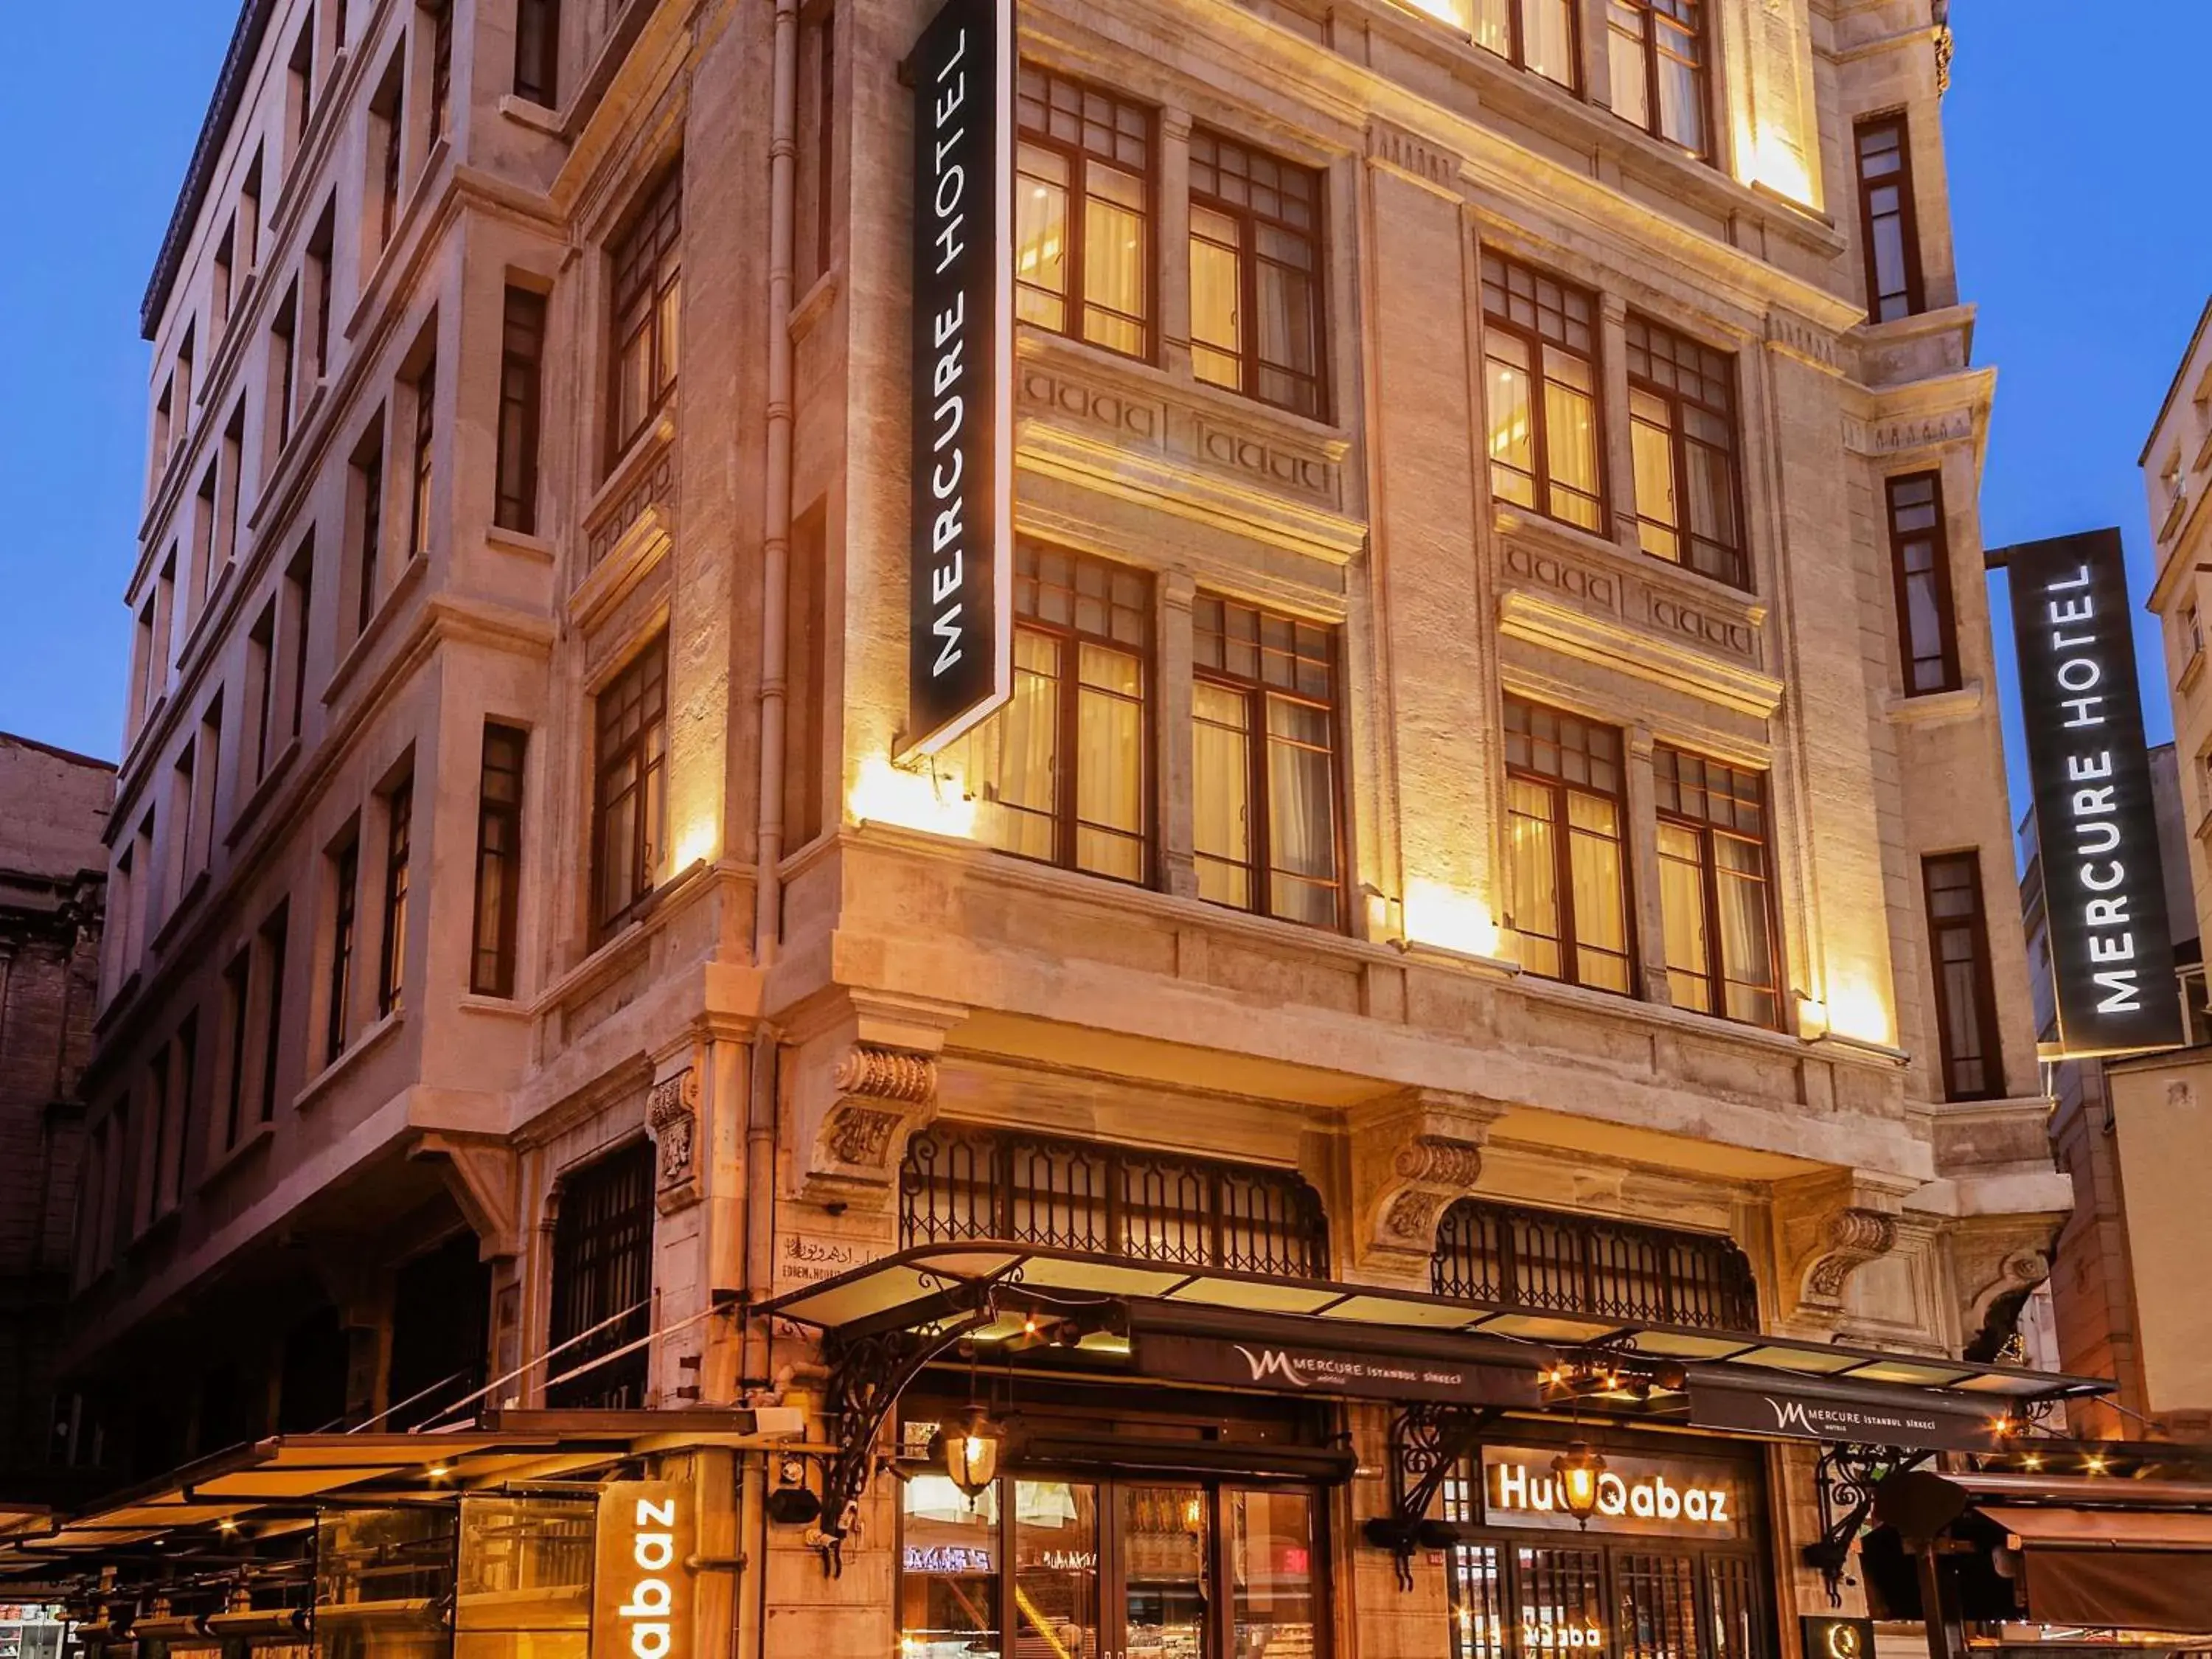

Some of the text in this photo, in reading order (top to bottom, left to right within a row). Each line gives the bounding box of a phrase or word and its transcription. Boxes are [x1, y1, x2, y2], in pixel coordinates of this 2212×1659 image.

[933, 27, 965, 677] MERCURE HOTEL
[2048, 564, 2141, 1015] MERCURE HOTEL
[1293, 1358, 1364, 1377] MERCURE
[1808, 1409, 1860, 1424] MERCURE
